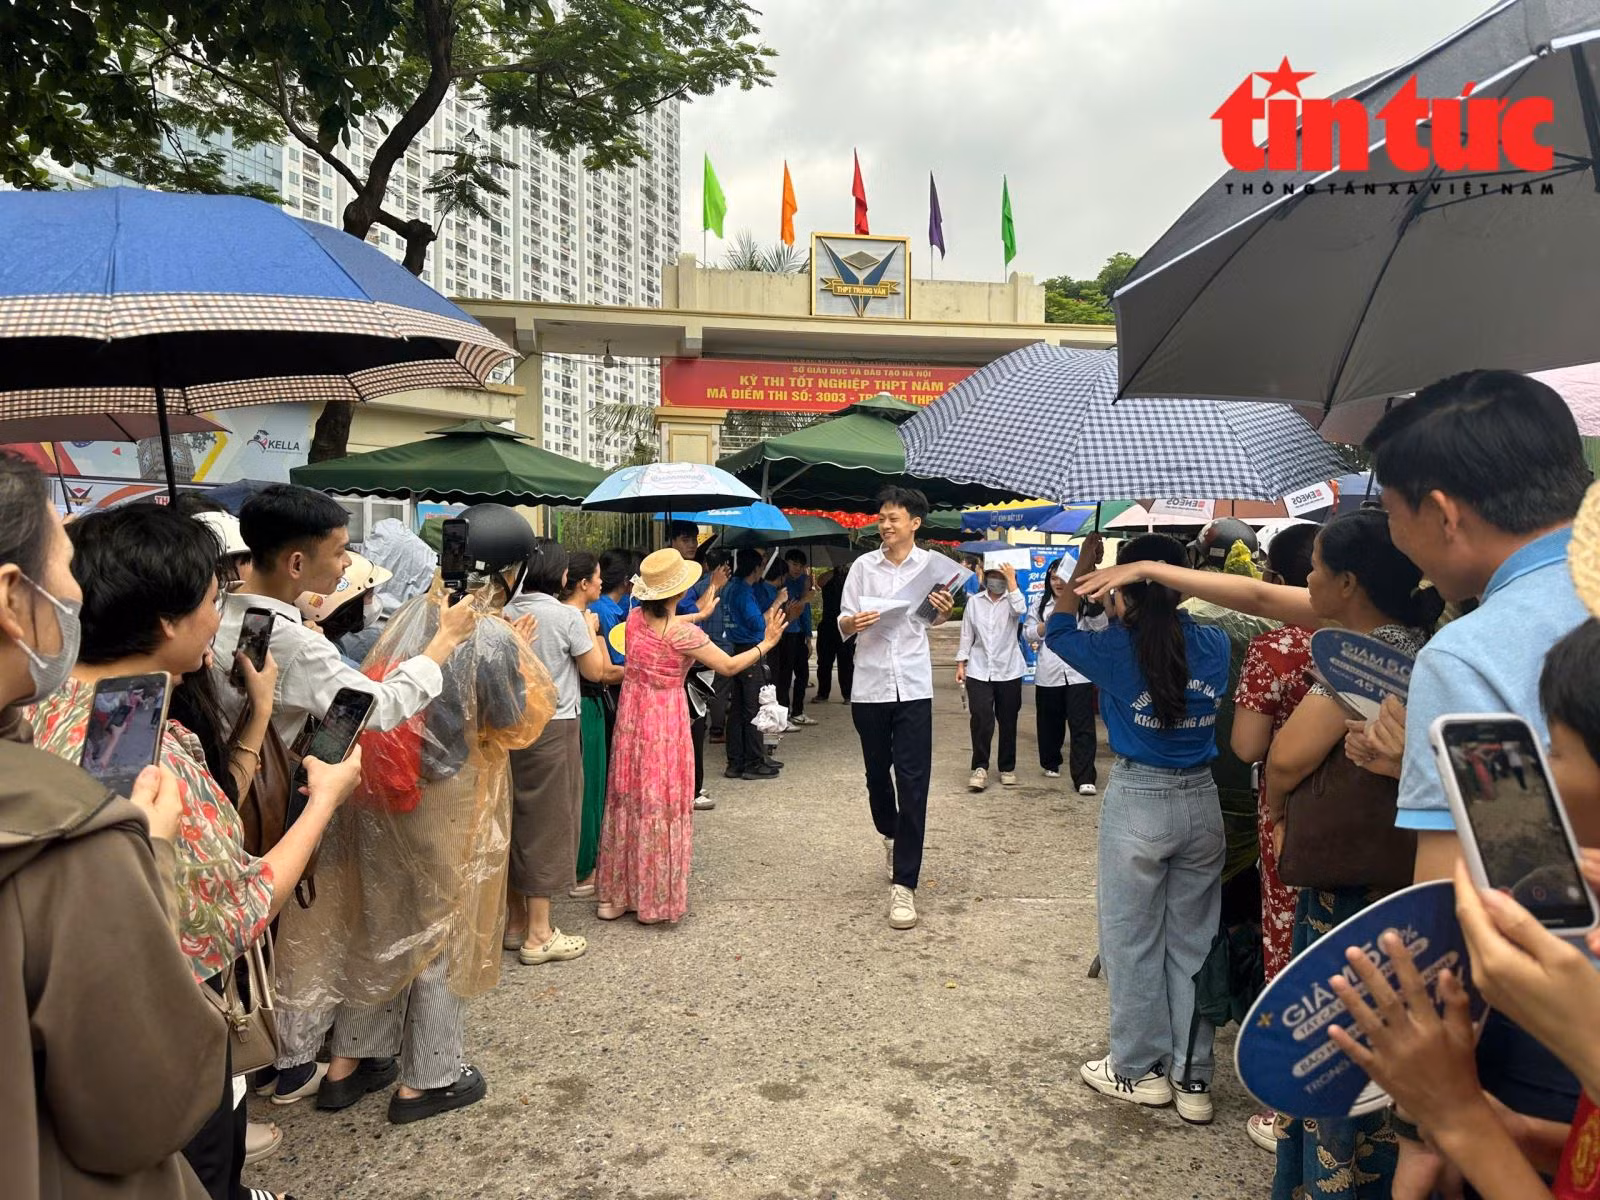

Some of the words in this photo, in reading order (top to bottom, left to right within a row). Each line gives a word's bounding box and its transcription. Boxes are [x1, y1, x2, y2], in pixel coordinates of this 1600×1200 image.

[739, 373, 758, 386] KỲ
[762, 376, 785, 387] THI
[788, 374, 814, 388] TỐT
[818, 377, 870, 391] NGHIỆP
[874, 379, 908, 391] THPT
[911, 378, 944, 392] NĂM
[706, 386, 728, 399] MÃ
[731, 385, 765, 400] ĐIỂM
[767, 390, 788, 401] THI
[791, 387, 812, 402] SỐ:
[816, 392, 846, 403] 3003
[267, 440, 300, 451] KELLA
